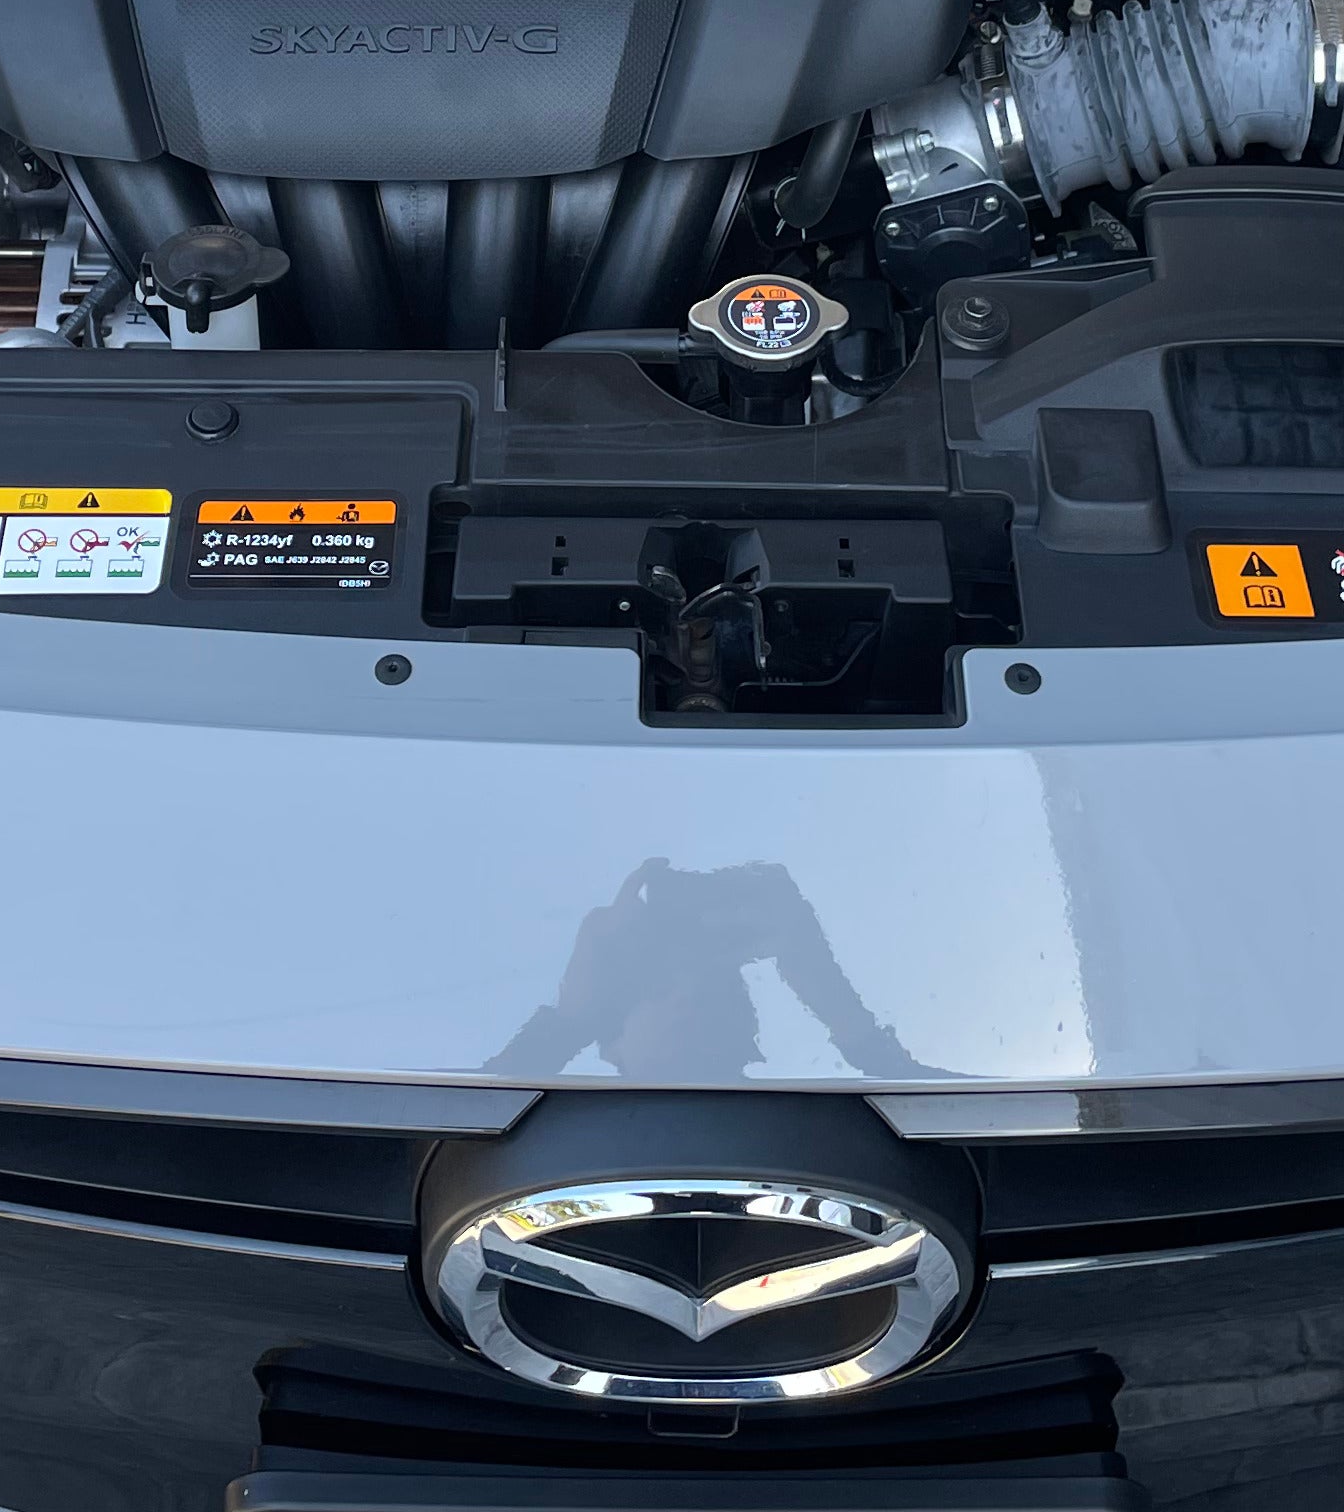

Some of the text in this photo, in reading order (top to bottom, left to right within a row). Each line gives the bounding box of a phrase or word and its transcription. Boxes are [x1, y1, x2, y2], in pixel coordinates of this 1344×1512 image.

[249, 23, 559, 54] SKYACTIV-G
[117, 526, 140, 538] OK
[226, 534, 375, 549] R-1234yf 0.360 kg
[223, 553, 258, 565] PAG
